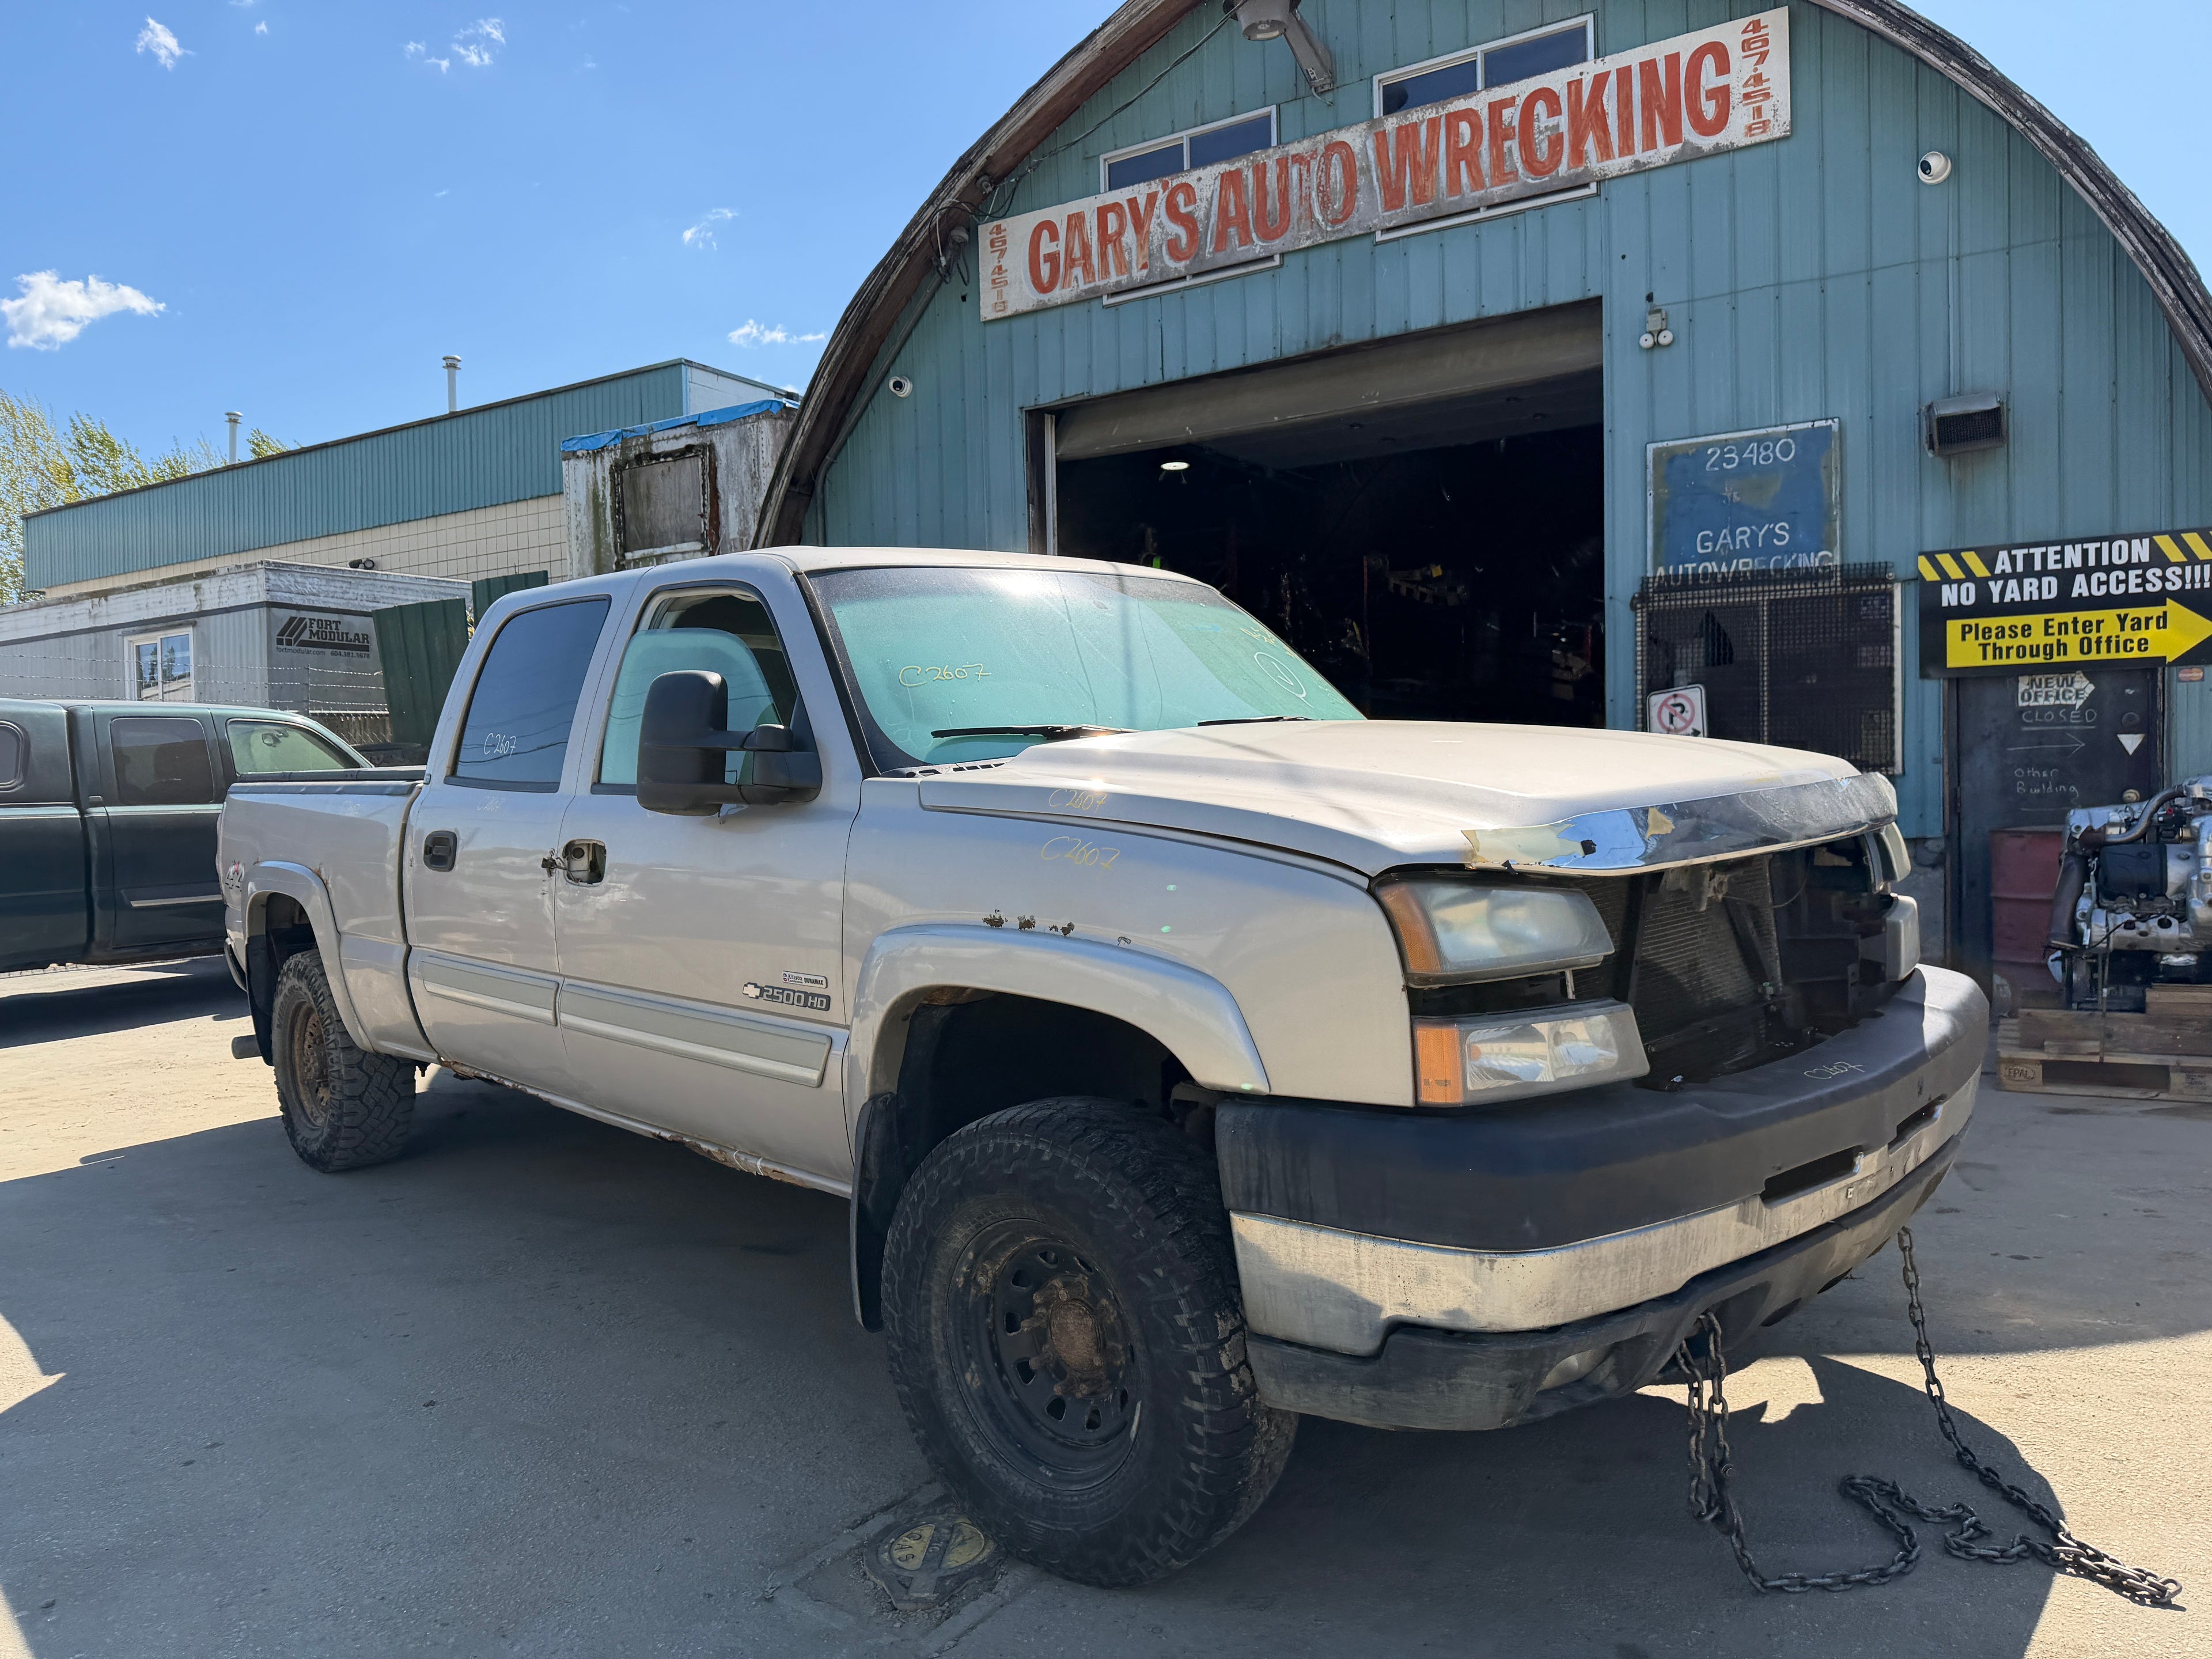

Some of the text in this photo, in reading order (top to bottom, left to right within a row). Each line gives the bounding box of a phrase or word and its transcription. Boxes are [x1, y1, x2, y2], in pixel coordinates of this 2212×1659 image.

[1028, 41, 1730, 294] GARY'S AUTO WRECKING
[1706, 438, 1796, 471] 23480
[1696, 522, 1789, 554] GARY'S
[1994, 537, 2150, 575] ATTENTION
[1941, 564, 2211, 607] NO YARD ACCESS!!!
[308, 618, 341, 631] FORT
[308, 628, 370, 644] MODULAR
[1961, 611, 2168, 641] Please Enter Yard
[276, 646, 325, 656] fortmodular.com
[1978, 635, 2149, 661] Through Office
[2020, 688, 2087, 703] OFFICE
[2028, 676, 2074, 690] NEW
[2022, 709, 2097, 724] CLOSED
[895, 1532, 922, 1562] GAS
